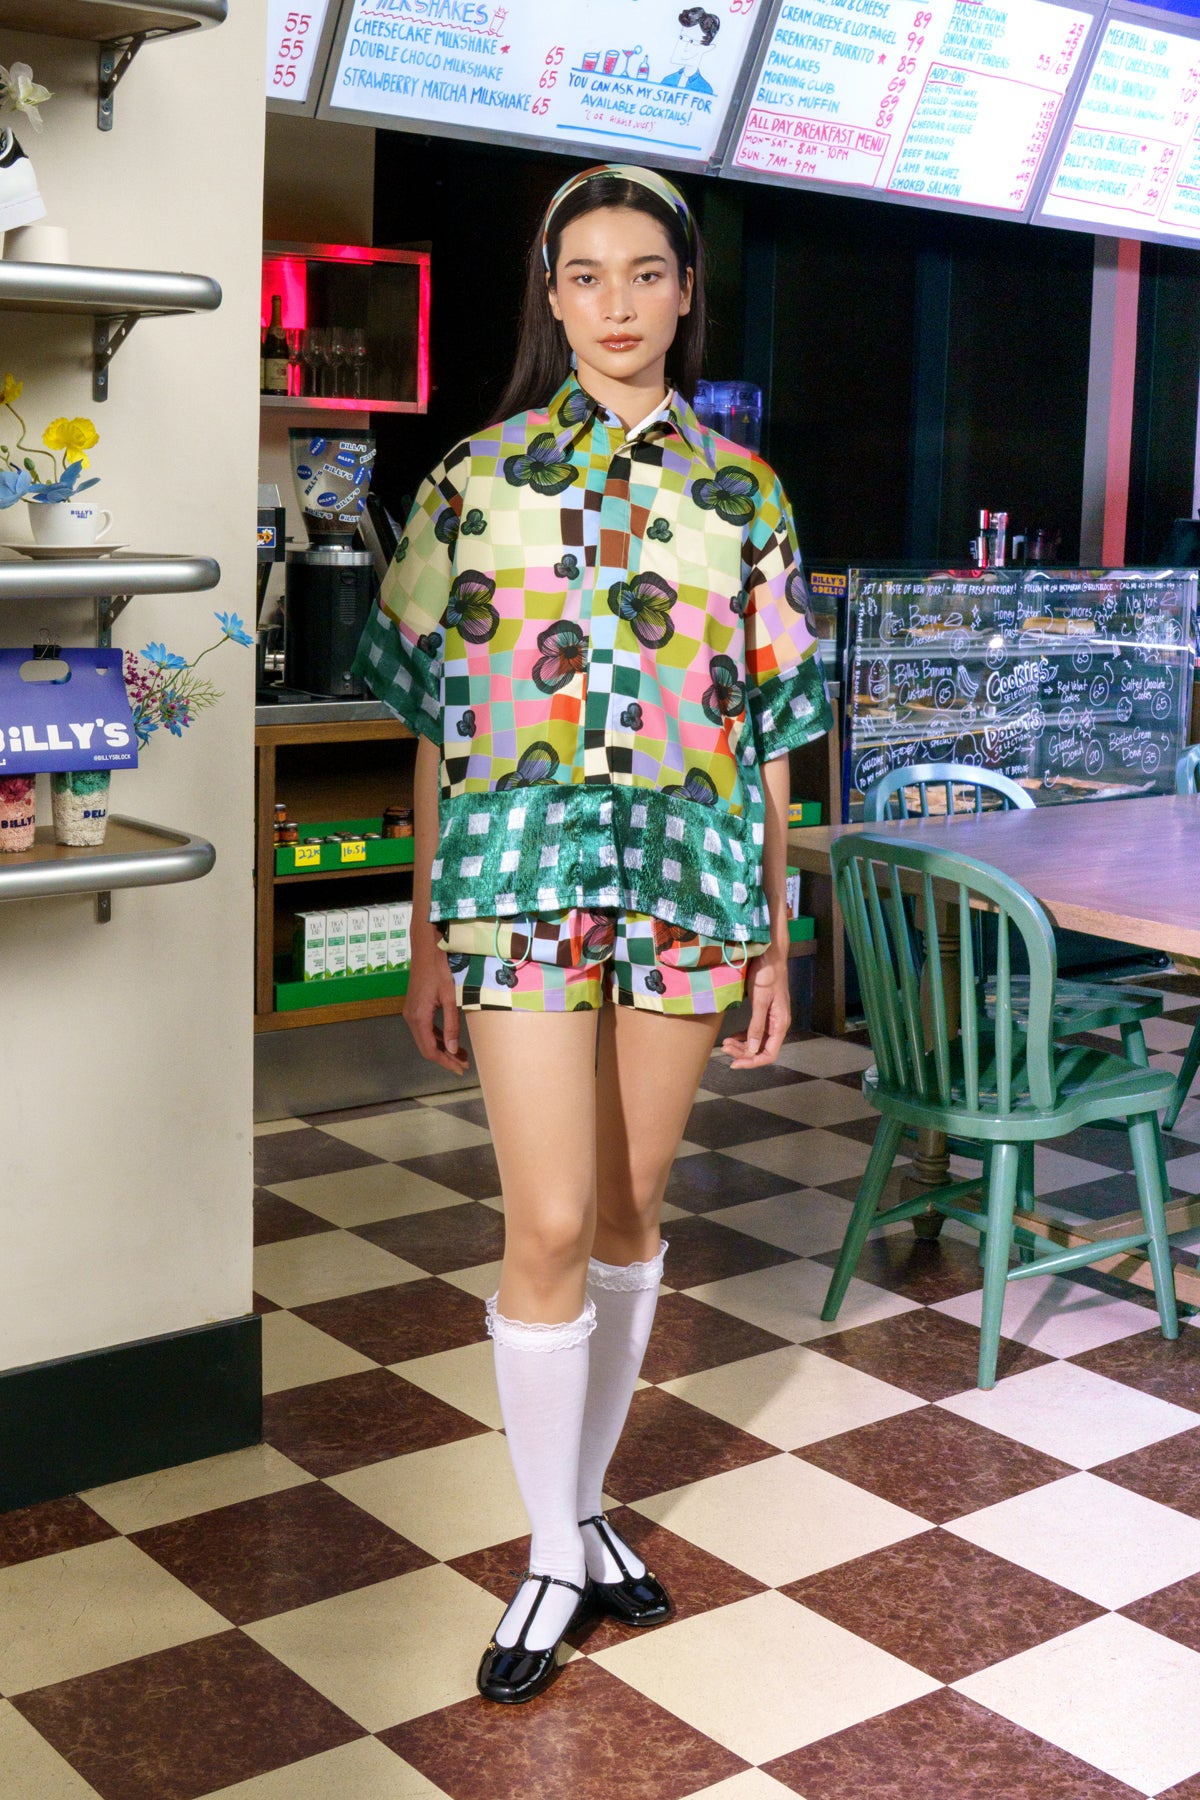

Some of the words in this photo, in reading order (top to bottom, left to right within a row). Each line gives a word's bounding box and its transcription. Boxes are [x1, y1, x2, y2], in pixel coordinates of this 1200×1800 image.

[285, 12, 312, 35] 55
[856, 0, 891, 18] CHEESE
[913, 11, 932, 29] 89
[953, 2, 980, 18] HASH
[980, 6, 1008, 24] BROWN
[1069, 23, 1085, 37] 25
[781, 5, 813, 25] CREAM
[813, 12, 844, 32] CHEESE
[843, 20, 851, 34] &
[851, 22, 870, 37] LOX
[869, 26, 897, 45] BAGEL
[908, 32, 925, 53] 99
[948, 15, 982, 34] FRENCH
[983, 23, 1005, 38] FRIES
[278, 38, 304, 60] 55
[354, 18, 432, 44] CHEESECAKE
[435, 30, 498, 55] MILKSHAKE
[545, 46, 565, 65] 65
[775, 28, 833, 53] BREAKFAST
[833, 41, 875, 64] BURRITO
[897, 55, 916, 75] 85
[943, 32, 969, 46] ONION
[969, 36, 993, 51] RINGS
[1105, 28, 1148, 51] MEATBALL
[1151, 40, 1168, 55] SUB
[349, 38, 399, 62] DOUBLE
[400, 48, 441, 69] CHOCO
[443, 58, 503, 81] MILKSHAKE
[539, 69, 558, 88] 65
[939, 44, 975, 62] CHICKEN
[977, 52, 1011, 69] TENDERS
[273, 64, 296, 87] 55
[767, 50, 820, 74] PANCAKES
[887, 77, 906, 93] 69
[343, 67, 420, 97] STRAWBERRY
[421, 79, 467, 104] MATCHA
[470, 86, 532, 111] MILKSHAKE
[532, 97, 551, 115] 65
[569, 73, 588, 88] YOU
[591, 80, 610, 92] CAN
[611, 83, 634, 95] ASK
[636, 87, 653, 99] MY
[653, 89, 690, 106] STAFF
[690, 97, 712, 114] FOR
[762, 70, 805, 89] MORNING
[807, 80, 835, 95] CLUB
[880, 95, 899, 112] 69
[580, 93, 636, 115] AVAILABLE
[639, 104, 693, 126] COCKTAILS!
[756, 87, 794, 107] BILLY'S
[798, 95, 840, 113] MUFFIN
[875, 110, 894, 129] 89
[749, 114, 769, 130] ALL
[771, 118, 794, 135] DAY
[794, 121, 855, 146] BREAKFAST
[855, 132, 886, 152] MENU
[906, 134, 955, 147] MUSHROOMS
[1070, 130, 1106, 149] CHICKEN
[1106, 136, 1141, 156] BURGER
[740, 147, 760, 160] SUN
[902, 148, 923, 158] BEEF
[924, 150, 950, 161] BACON
[896, 161, 920, 173] LAMB
[890, 178, 925, 192] SMOKED
[927, 180, 962, 197] SALMON
[877, 583, 883, 595] A
[885, 583, 902, 595] TASTE
[903, 584, 911, 595] OF
[913, 584, 924, 595] NEW
[968, 584, 985, 595] FRESH
[993, 599, 1015, 626] Honey
[1017, 600, 1041, 620] Butter
[998, 623, 1018, 639] Toast
[989, 649, 1003, 664] 50
[1077, 651, 1089, 664] 65
[922, 659, 952, 679] Banana
[899, 680, 933, 706] Custard
[1004, 683, 1039, 704] SELECTIONS
[1093, 682, 1105, 699] 65
[1155, 697, 1167, 711] 65
[994, 731, 1032, 757] SELECTIONS
[1109, 731, 1133, 752] Boston
[93, 753, 131, 761] @BILLYSBLOCK
[1089, 750, 1100, 765] 20
[1144, 751, 1157, 764] 35
